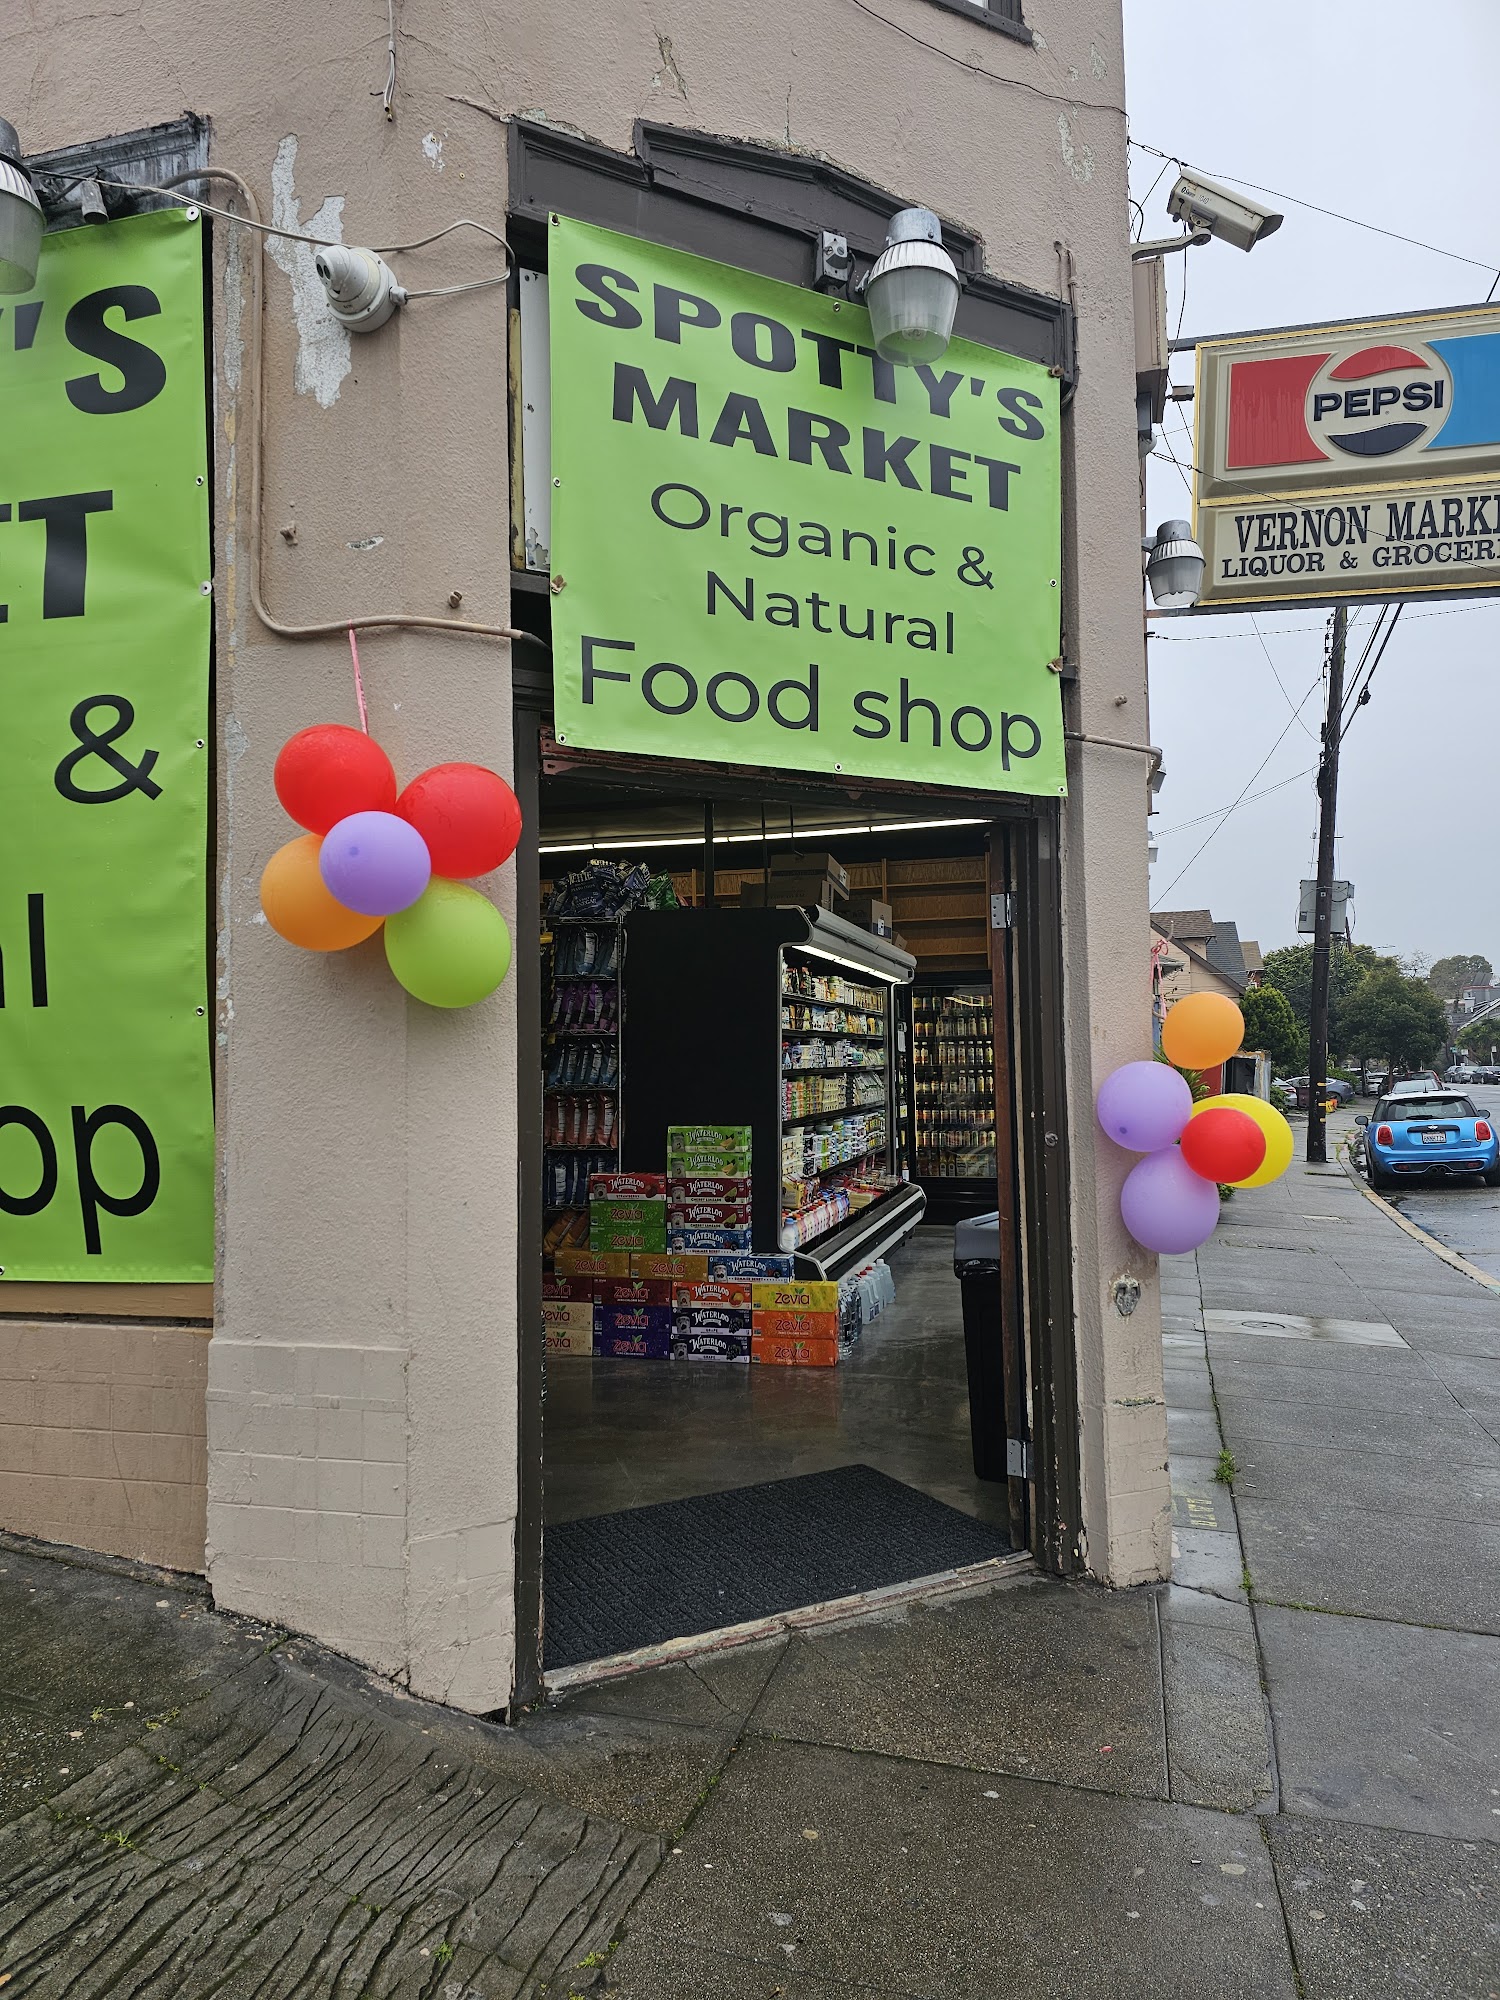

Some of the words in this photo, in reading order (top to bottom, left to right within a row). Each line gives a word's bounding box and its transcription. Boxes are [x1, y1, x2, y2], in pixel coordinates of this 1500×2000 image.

[0, 285, 167, 415] 'S
[575, 263, 1045, 441] SPOTTY'S
[1314, 380, 1444, 421] PEPSI
[612, 361, 1021, 511] MARKET
[1235, 504, 1371, 553] VERNON
[1386, 495, 1500, 542] MARK
[650, 483, 936, 577] Organic
[957, 546, 995, 590] &
[0, 489, 113, 623] T
[1222, 552, 1325, 578] LIQUOR
[1340, 551, 1358, 570] &
[1372, 539, 1500, 568] GROCER
[707, 571, 954, 655] Natural
[581, 635, 819, 732] Food
[852, 678, 1042, 771] shop
[54, 694, 164, 805] &
[686, 1127, 723, 1144] WATERLOO
[687, 1153, 724, 1169] WATERLOO
[608, 1175, 645, 1192] WATERLOO
[686, 1178, 723, 1195] WATERLOO
[686, 1204, 723, 1221] WATERLOO
[686, 1230, 723, 1247] WATERLOO
[728, 1257, 767, 1274] WATERLOO
[692, 1282, 730, 1299] WATERLOO
[542, 1309, 570, 1322] evia
[692, 1308, 730, 1326] WATERLOO
[545, 1337, 571, 1348] evia
[689, 1334, 727, 1353] WATERLOO
